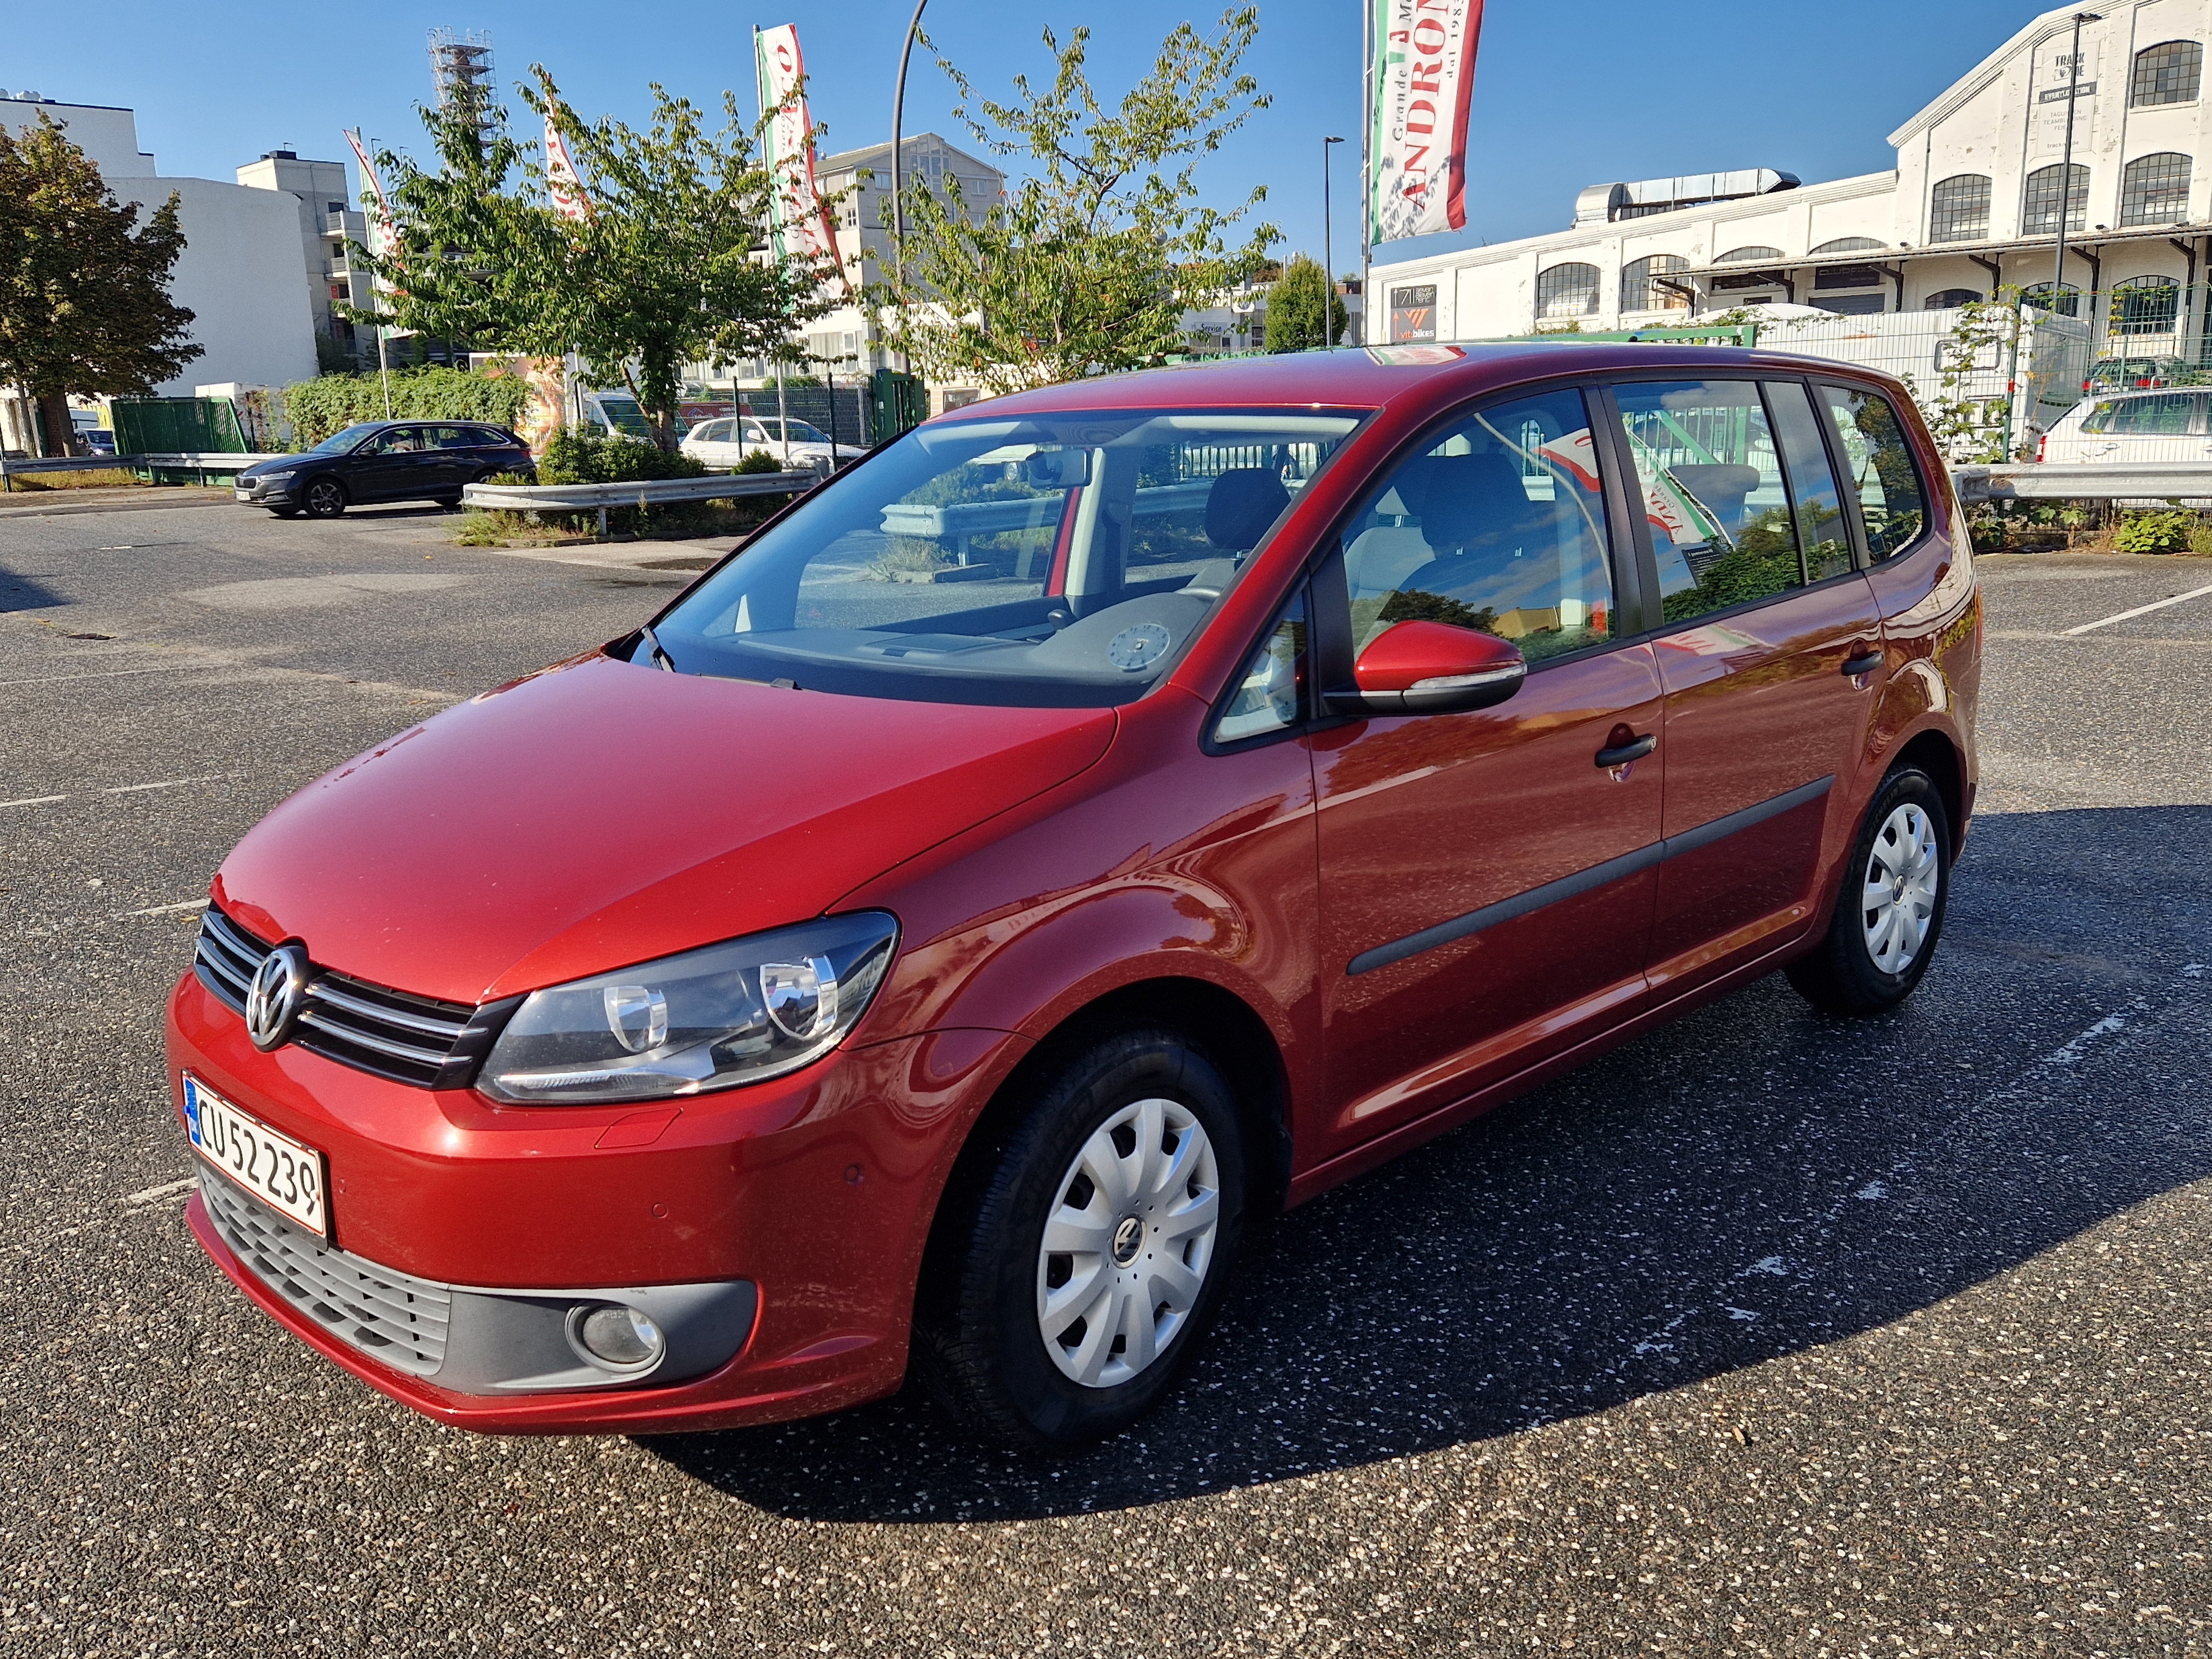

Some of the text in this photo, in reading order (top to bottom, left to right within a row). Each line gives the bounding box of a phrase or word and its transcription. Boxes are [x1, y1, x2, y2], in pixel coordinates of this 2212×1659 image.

[1447, 51, 1457, 79] dal
[2054, 52, 2085, 67] TRAK
[2044, 85, 2090, 100] EVENTLOATION
[1393, 70, 1408, 142] Grande
[2051, 109, 2082, 118] TAGUEN
[2044, 116, 2087, 125] TEAMBUDING
[1202, 324, 1222, 332] Service
[199, 1099, 316, 1217] CU 52 239
